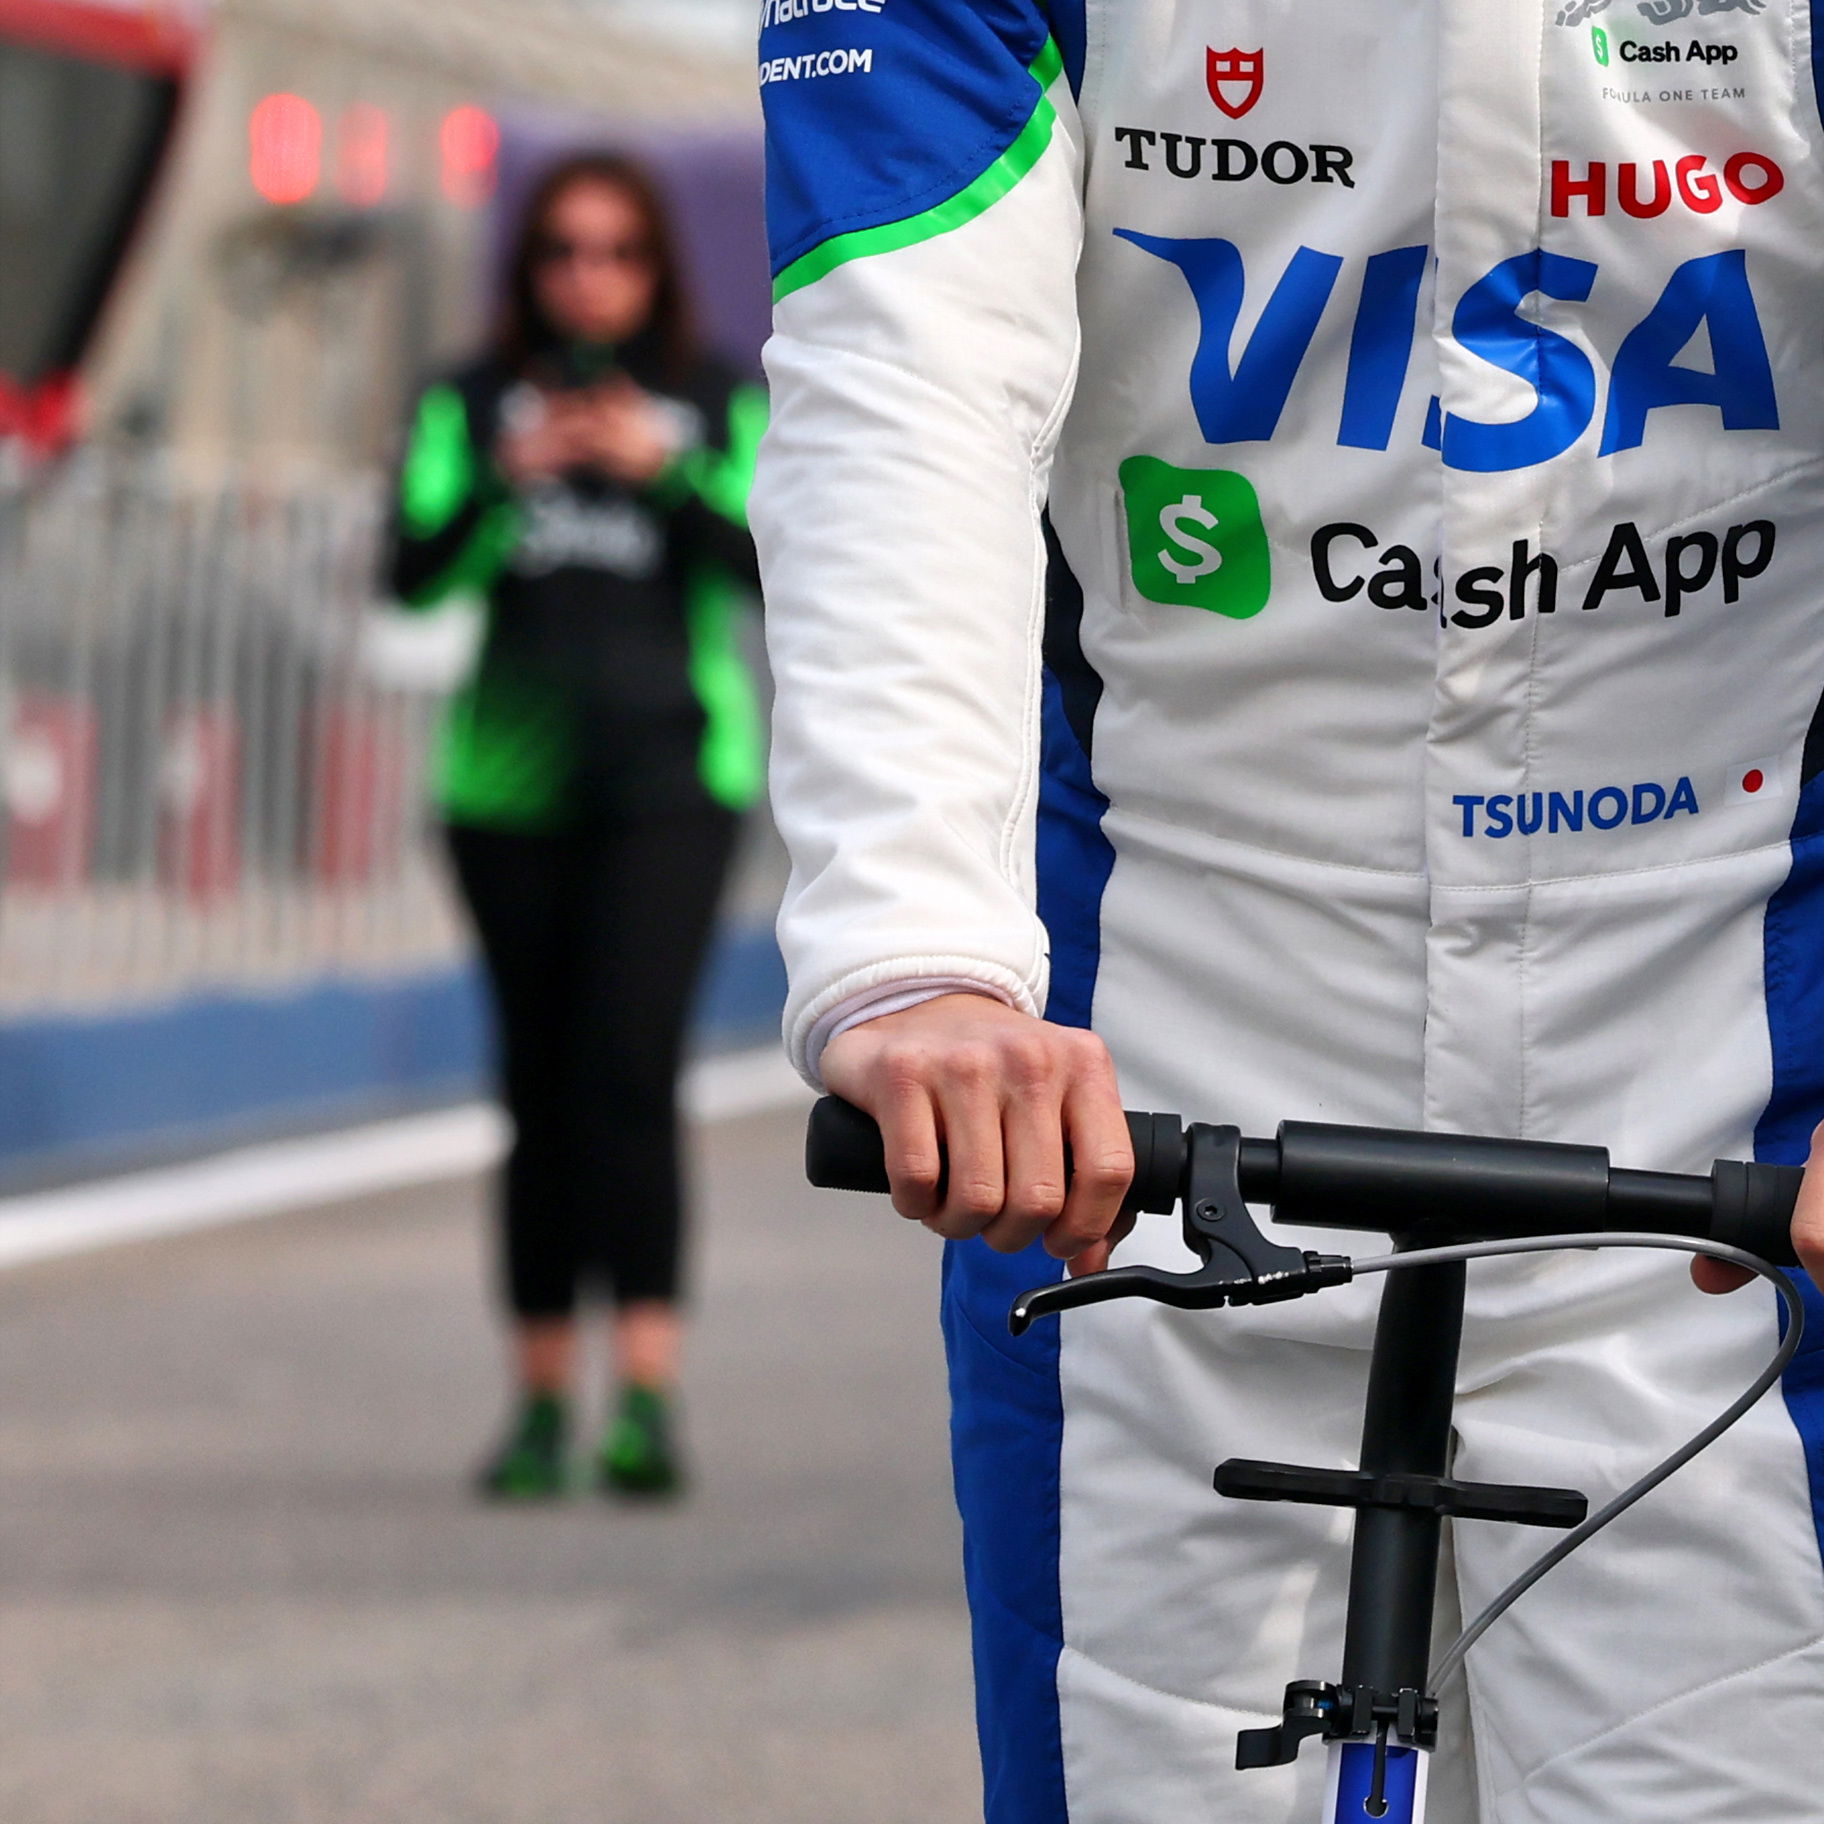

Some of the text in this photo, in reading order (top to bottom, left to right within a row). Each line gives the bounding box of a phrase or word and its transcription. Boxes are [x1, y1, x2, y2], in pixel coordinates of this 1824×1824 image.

[1620, 40, 1680, 62] Cash
[1686, 40, 1738, 65] App
[1659, 90, 1693, 102] ONE
[1701, 88, 1745, 101] TEAM
[1115, 127, 1355, 189] TUDOR
[1550, 151, 1784, 219] HUGO
[1113, 227, 1780, 473] VISA
[1310, 522, 1557, 628] Cash
[1582, 519, 1776, 618] App
[1453, 777, 1699, 838] TSUNODA
